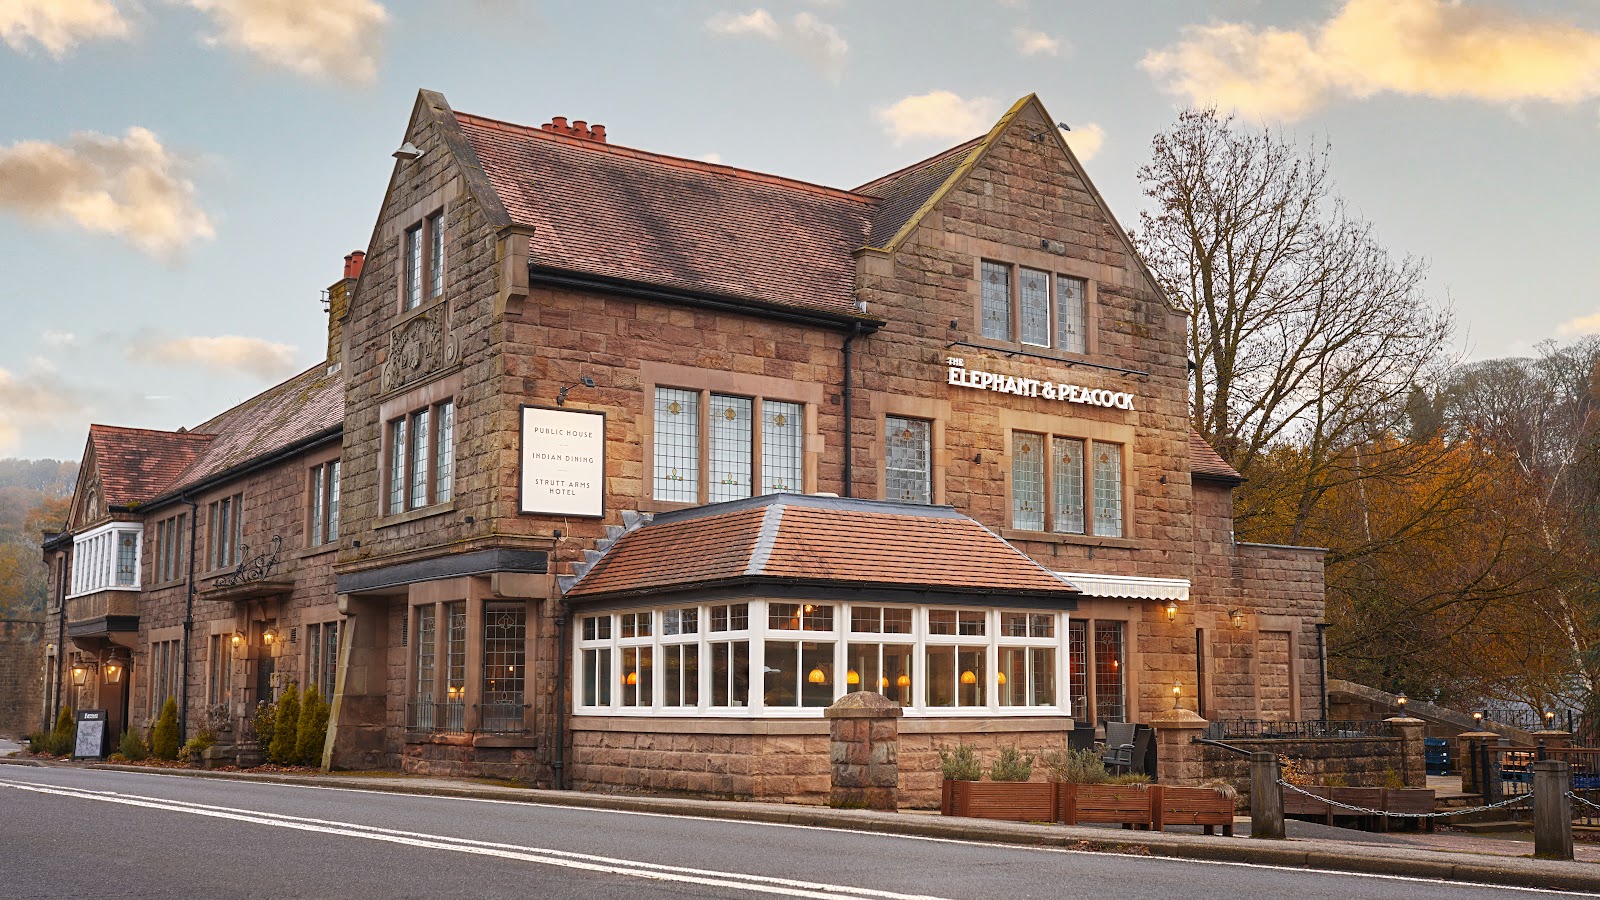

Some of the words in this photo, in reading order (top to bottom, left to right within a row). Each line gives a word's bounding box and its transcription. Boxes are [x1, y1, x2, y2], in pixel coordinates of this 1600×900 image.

[947, 356, 965, 367] THE
[948, 366, 1040, 398] ELEPHANT
[1041, 381, 1056, 400] &
[1058, 383, 1135, 411] PEACOCK
[534, 427, 563, 436] PUBLIC
[566, 430, 593, 438] HOUSE
[532, 452, 562, 461] INDIAN
[565, 455, 594, 464] DINING
[535, 478, 565, 487] STRUTT
[568, 481, 590, 489] ARMS
[549, 488, 576, 496] HOTEL
